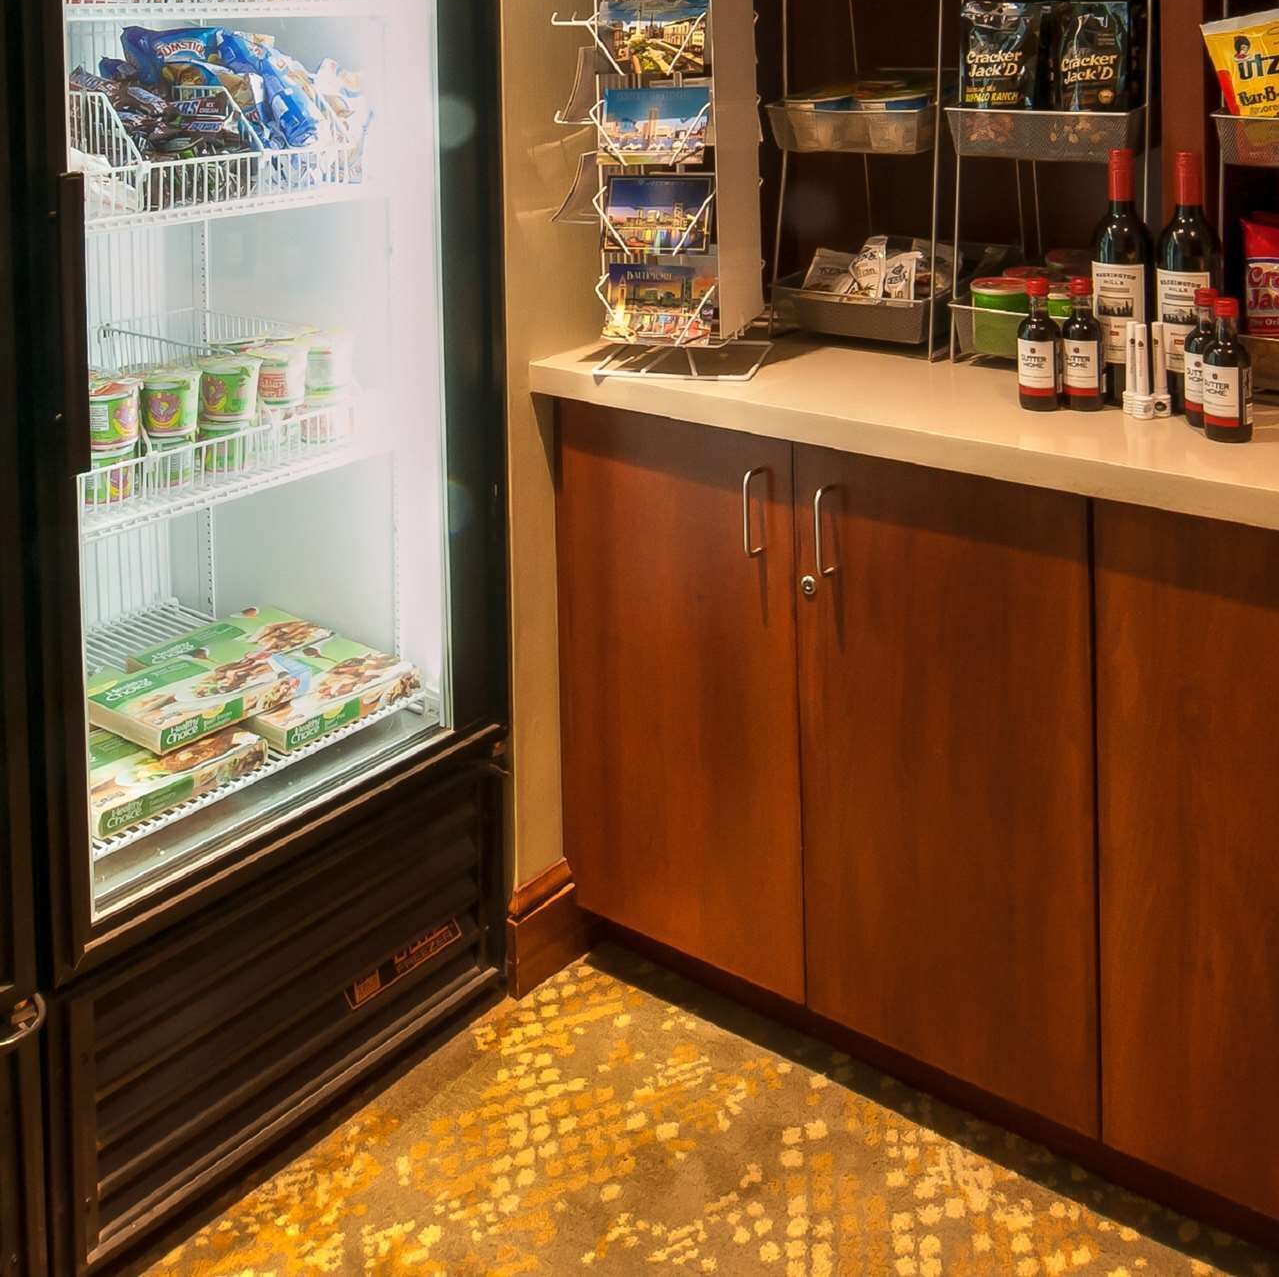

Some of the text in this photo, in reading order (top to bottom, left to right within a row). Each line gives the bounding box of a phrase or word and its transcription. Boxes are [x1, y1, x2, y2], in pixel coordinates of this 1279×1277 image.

[966, 49, 1024, 64] Cracker
[1061, 54, 1118, 72] Cracker
[968, 62, 1018, 77] Jack'D
[1064, 66, 1114, 84] Jack'D
[1187, 368, 1203, 376] SUTT
[166, 725, 200, 746] Choice
[290, 726, 322, 748] Choice
[106, 809, 144, 831] Choice
